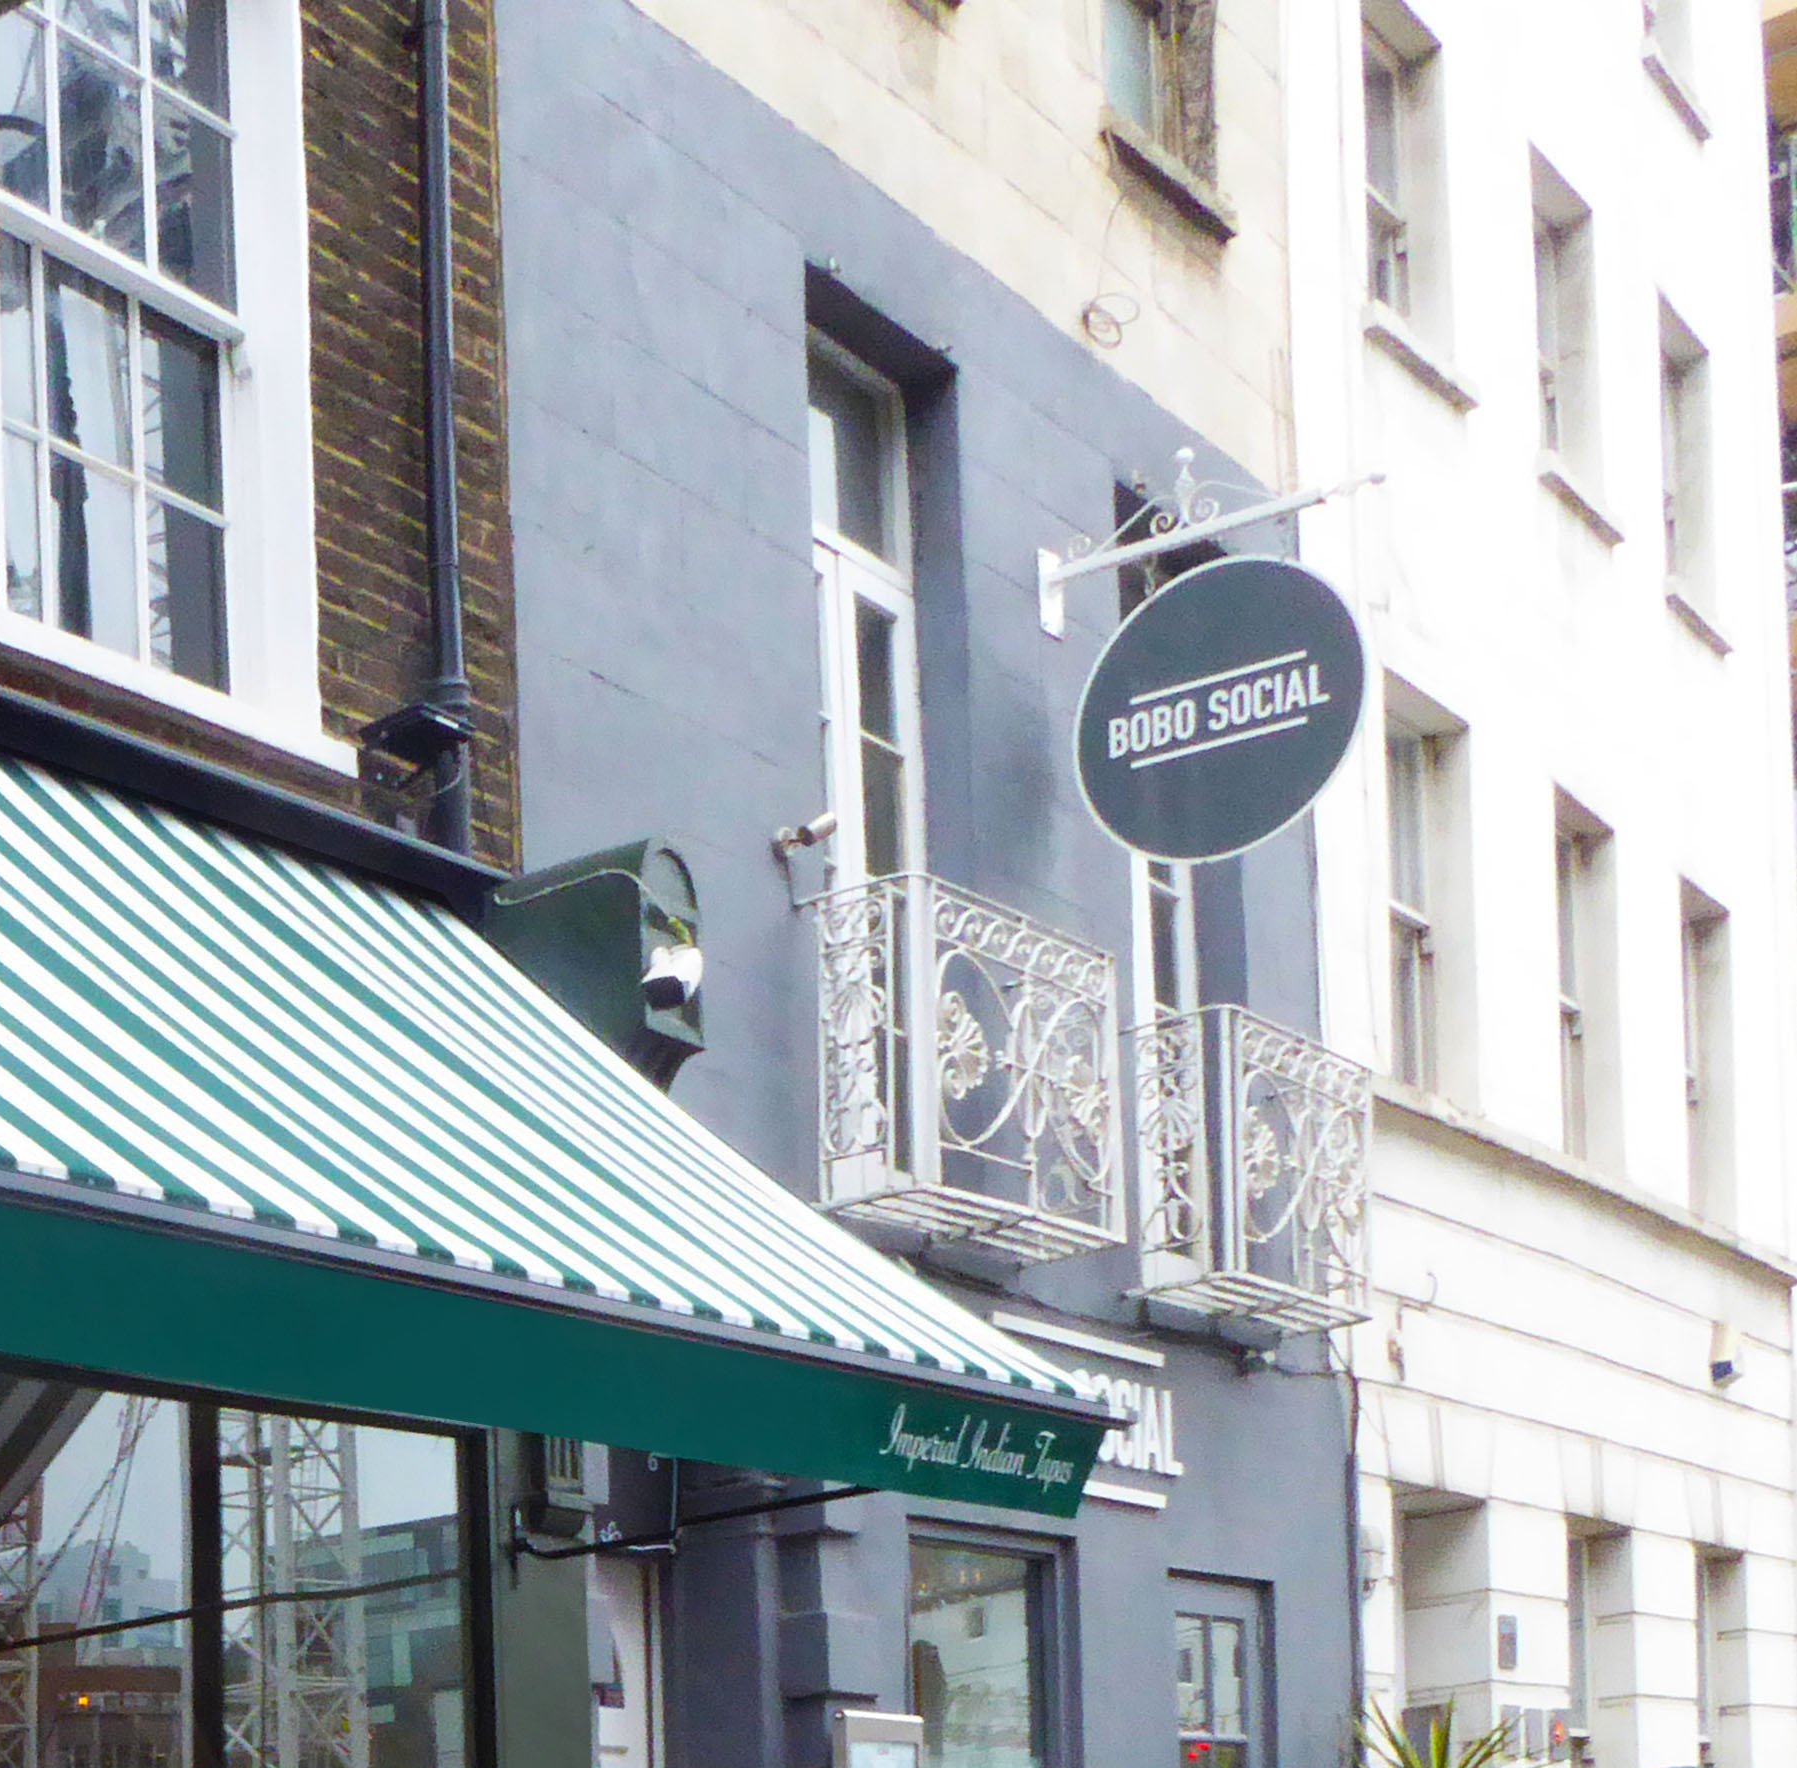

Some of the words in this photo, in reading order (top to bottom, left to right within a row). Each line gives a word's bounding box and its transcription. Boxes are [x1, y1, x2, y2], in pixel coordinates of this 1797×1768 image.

[1108, 699, 1196, 759] BOBO
[1208, 664, 1331, 731] SOCIAL
[879, 1403, 970, 1472] Imperial
[960, 1419, 1025, 1475] Indian
